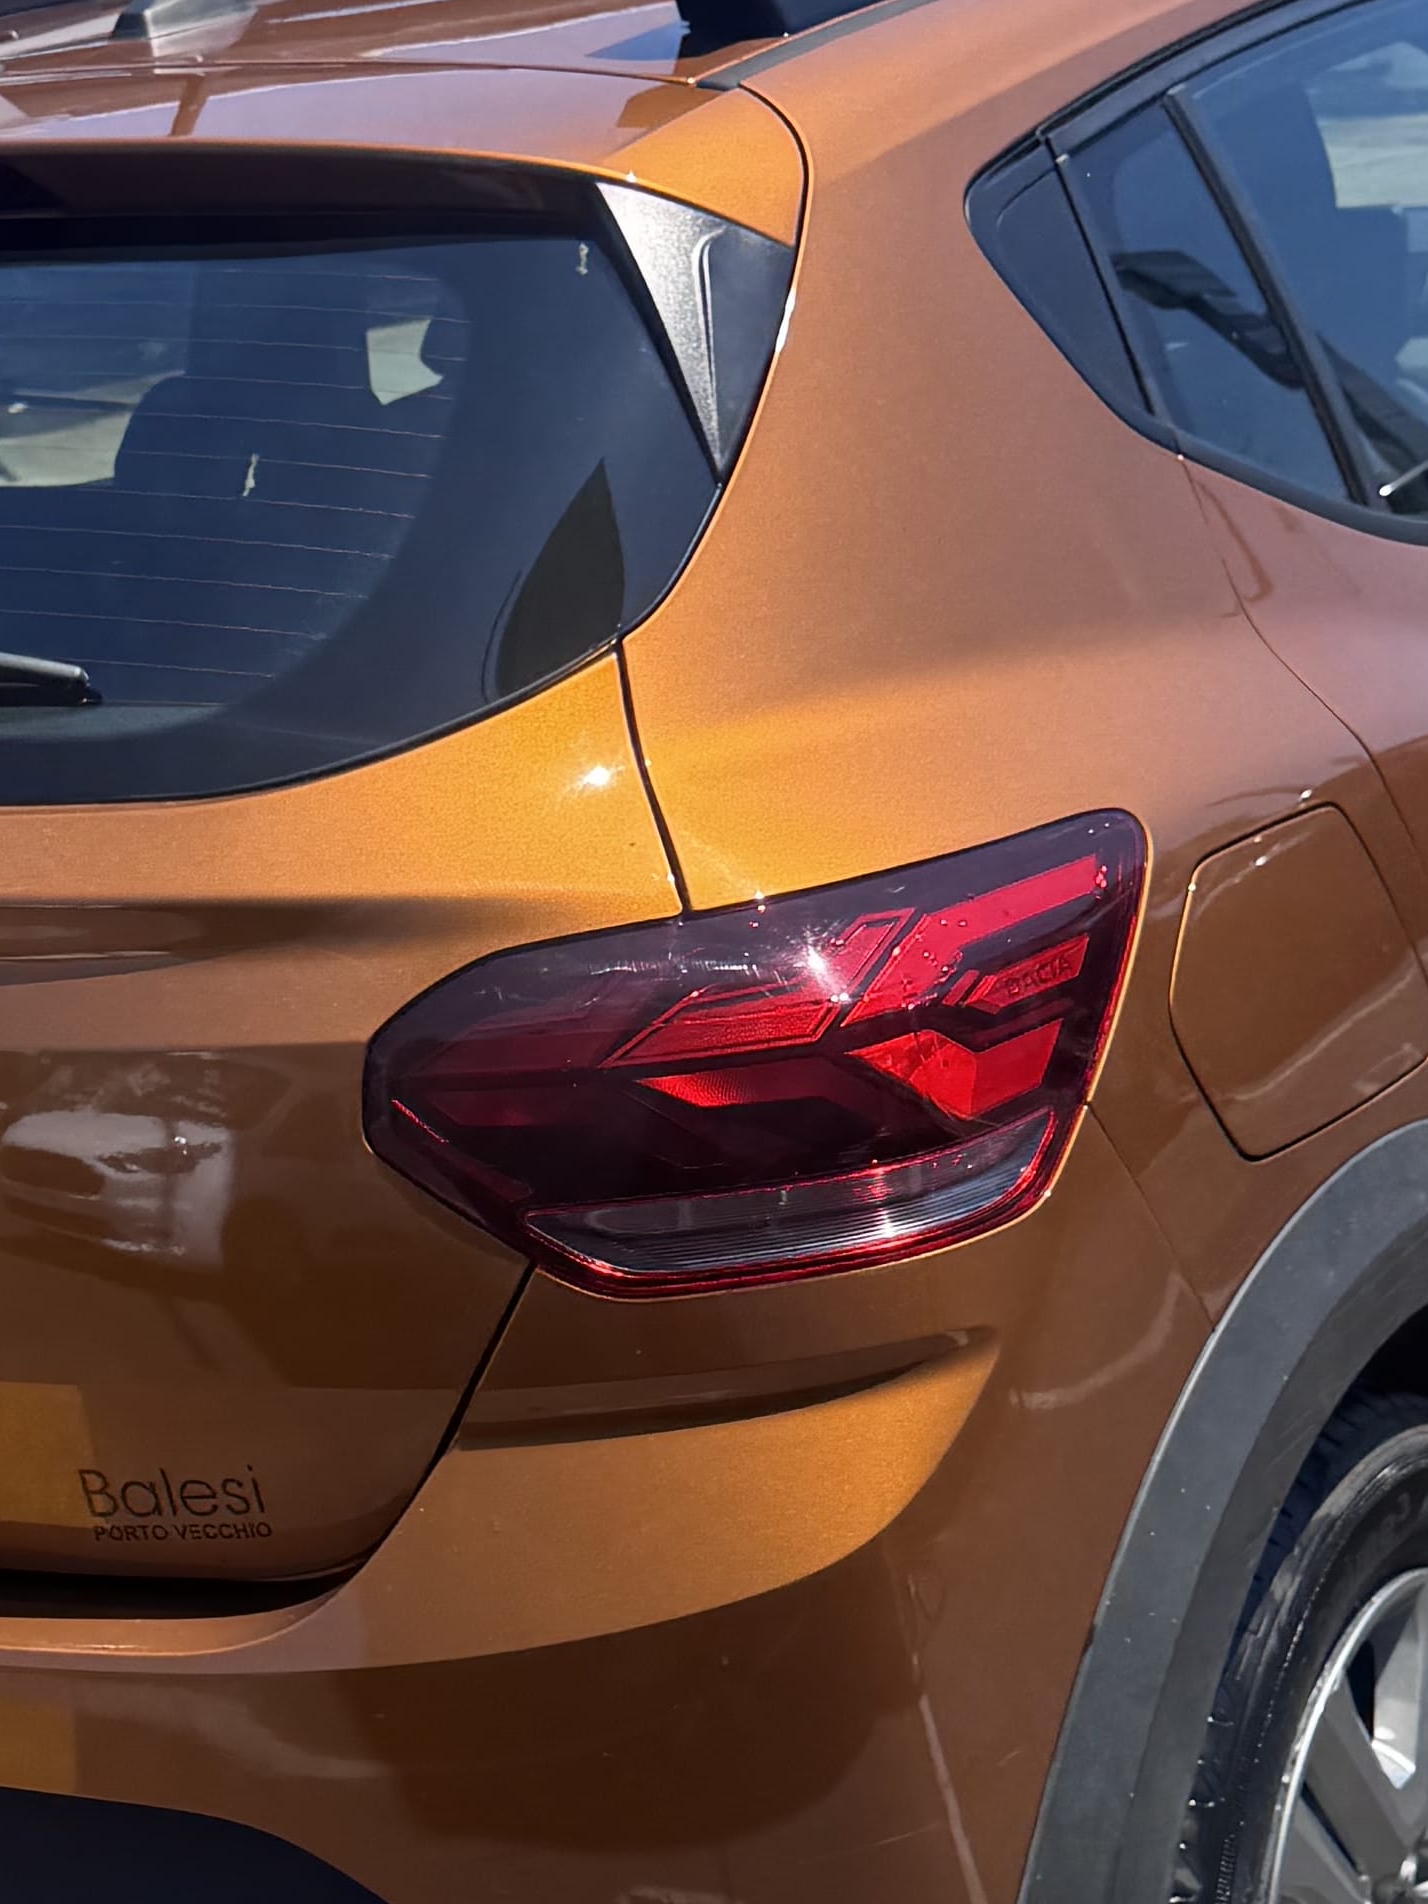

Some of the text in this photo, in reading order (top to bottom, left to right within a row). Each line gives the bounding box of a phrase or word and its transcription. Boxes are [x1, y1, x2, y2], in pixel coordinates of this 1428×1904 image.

[79, 1464, 265, 1518] Balesi
[94, 1521, 272, 1541] PORTO VECCHIO
